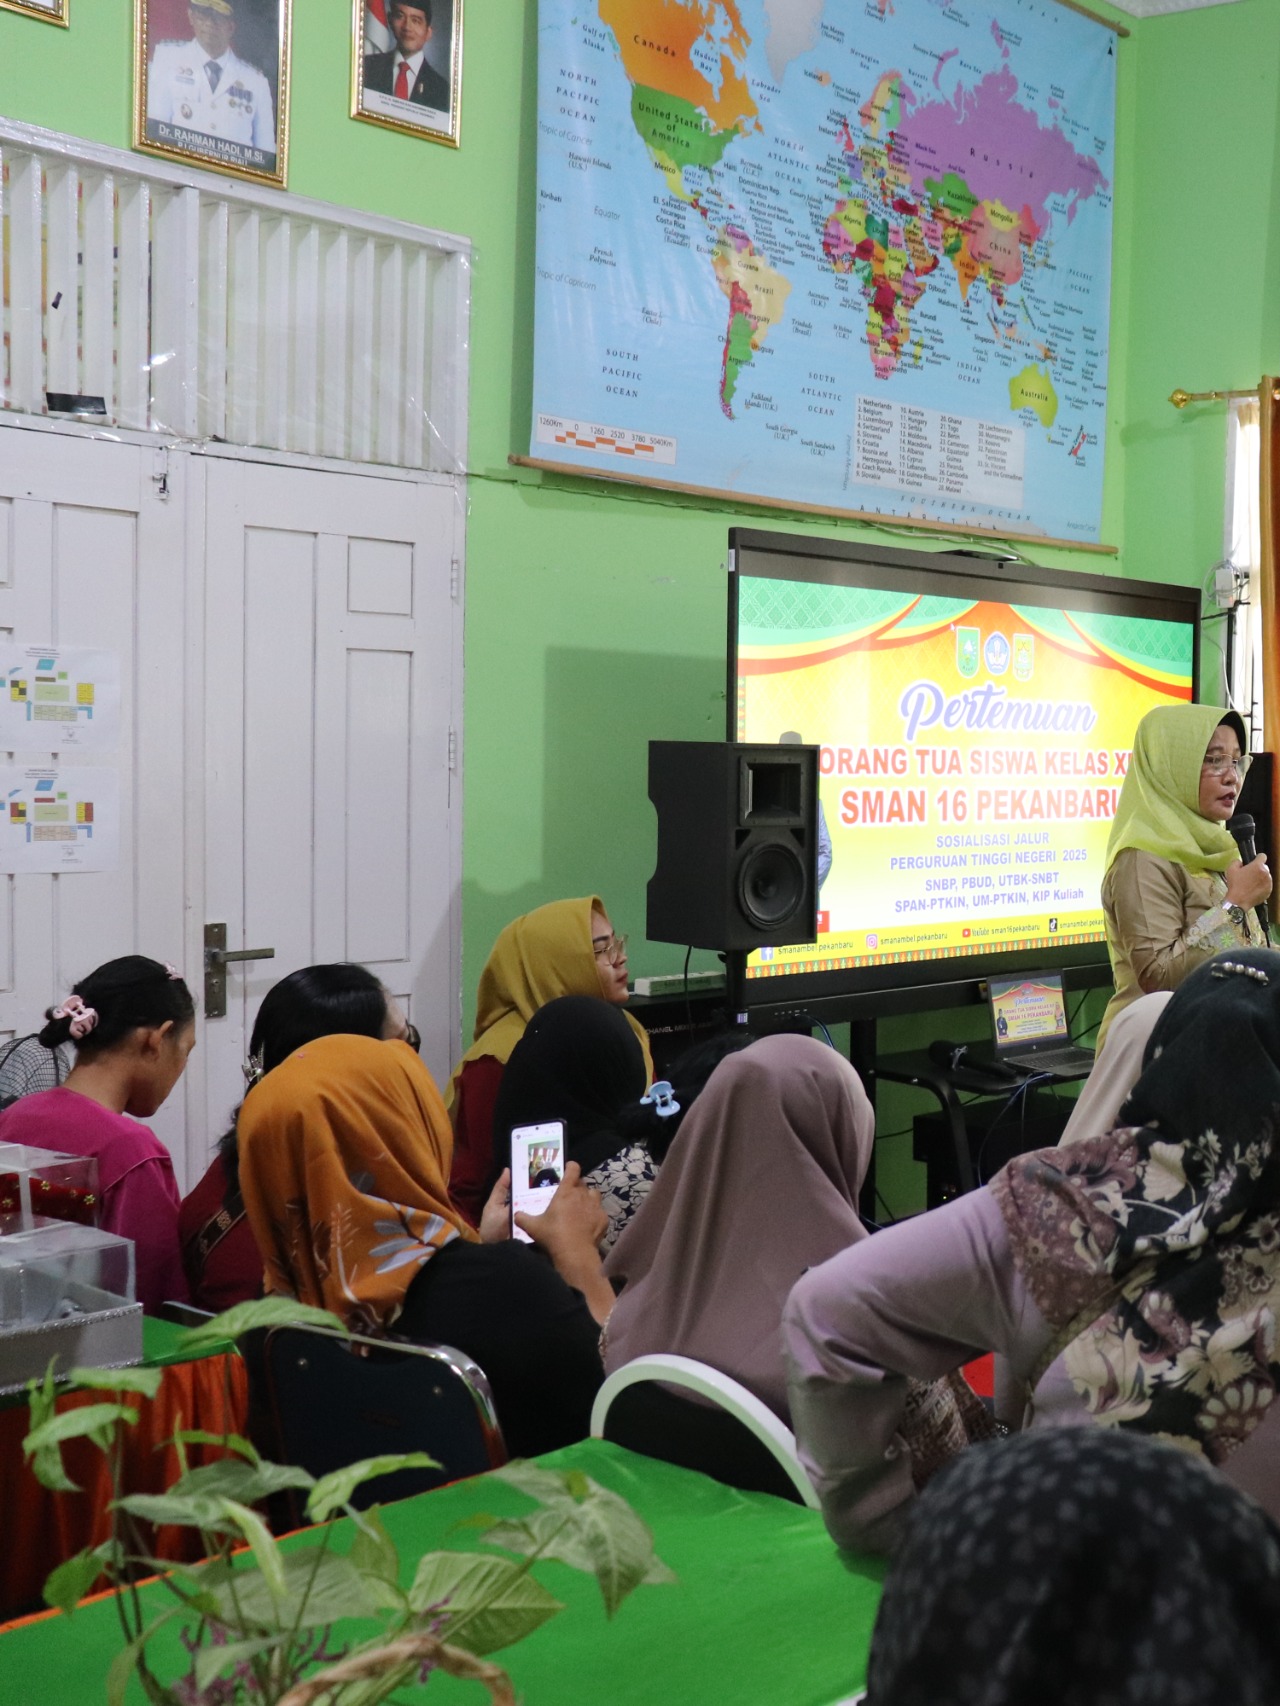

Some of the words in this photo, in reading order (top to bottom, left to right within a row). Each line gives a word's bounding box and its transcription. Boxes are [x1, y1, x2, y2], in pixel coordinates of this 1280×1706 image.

[634, 35, 677, 58] Canada
[559, 69, 598, 87] NORTH
[556, 86, 600, 106] PACIFIC
[559, 107, 597, 123] OCEAN
[638, 102, 672, 121] United
[674, 112, 704, 132] States
[159, 124, 173, 137] Dr.
[174, 128, 216, 149] RAHMAN
[217, 139, 242, 158] HADI,
[651, 128, 691, 149] America
[654, 161, 677, 175] Mexico
[606, 349, 639, 362] SOUTH
[602, 366, 643, 381] PACIFIC
[606, 385, 639, 398] OCEAN
[1020, 388, 1049, 403] Australia
[590, 425, 605, 437] 1260
[610, 429, 625, 440] 2520
[631, 433, 646, 444] 3780
[900, 682, 1097, 742] Pertemuan
[820, 747, 908, 775] ORANG
[916, 749, 963, 775] TUA
[970, 750, 1039, 775] SISWA
[1045, 752, 1109, 775] KELAS
[841, 790, 926, 824] SMAN
[937, 790, 967, 822] 16
[936, 834, 1010, 848] SOSIALISASI
[1014, 833, 1050, 845] JALUR
[890, 855, 967, 870] PERGURUAN
[971, 853, 1011, 866] TINGGI
[1015, 851, 1056, 864] NEGERI
[1062, 849, 1087, 862] 2025
[925, 879, 958, 892] SNBP,
[962, 876, 995, 890] PBUD,
[999, 872, 1059, 887] UTBK-SNBT
[895, 896, 969, 913] SPAN-PTKIN,
[973, 892, 1029, 907] UM-PTKIN,
[1033, 890, 1050, 902] KIP
[1054, 889, 1084, 901] Kuliah
